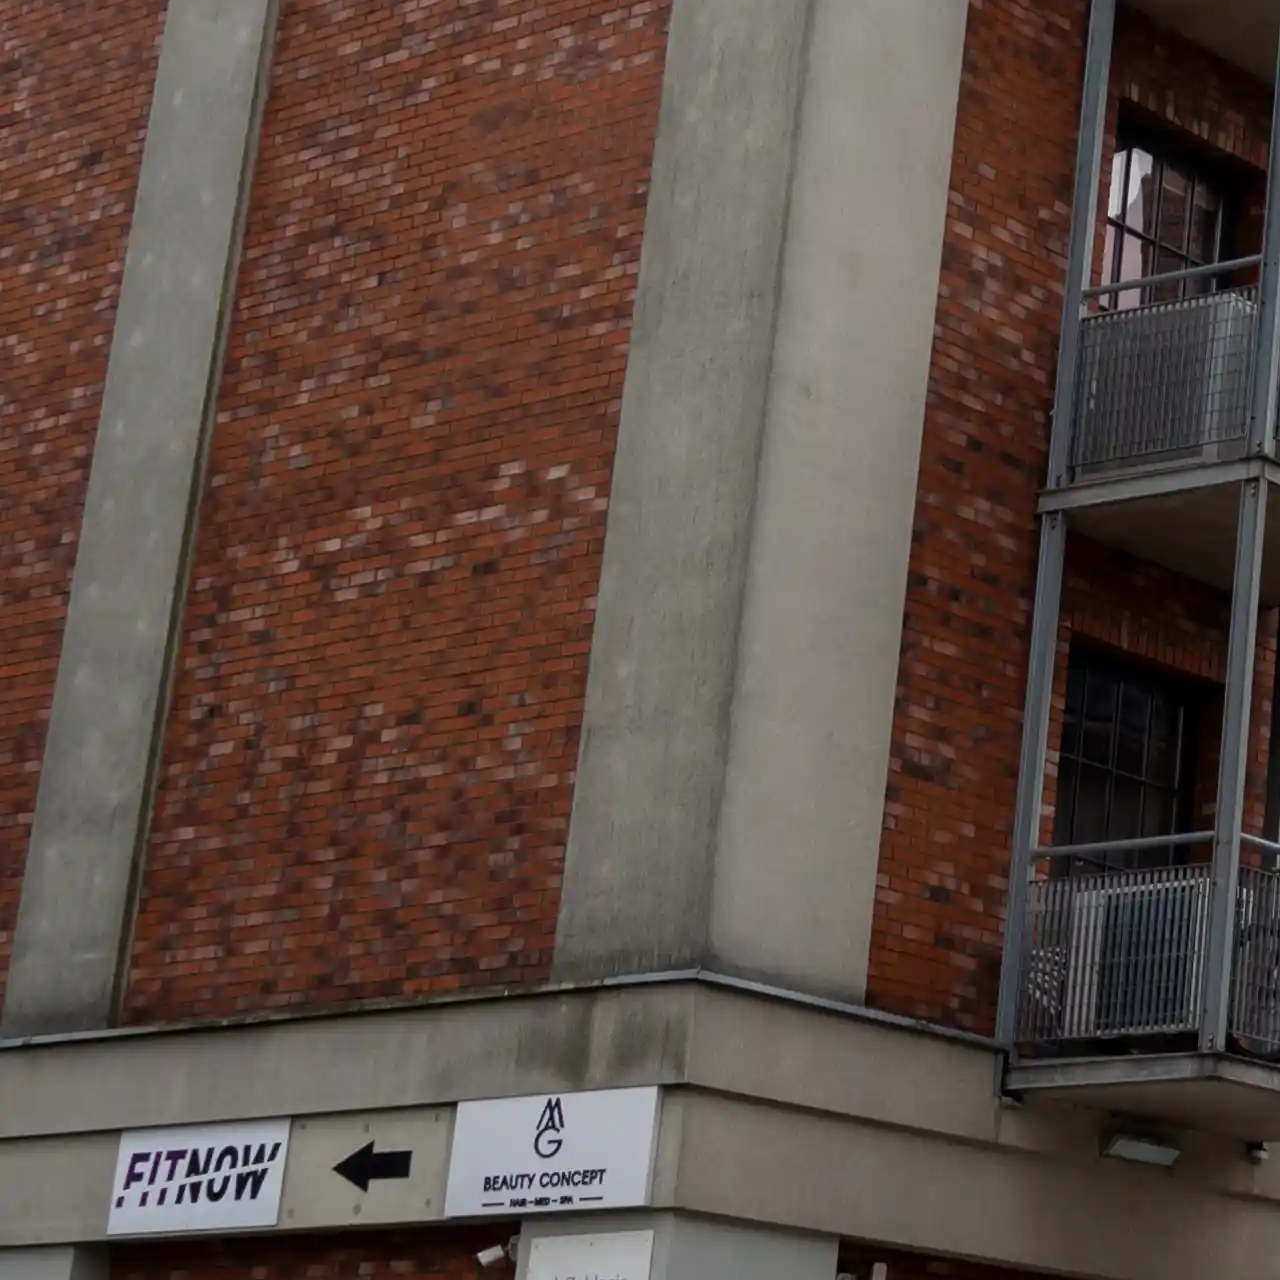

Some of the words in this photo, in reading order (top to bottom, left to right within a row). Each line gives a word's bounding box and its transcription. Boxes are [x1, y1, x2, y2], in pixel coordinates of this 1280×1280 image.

[115, 1142, 282, 1208] FITNOW
[483, 1172, 536, 1192] BEAUTY
[539, 1169, 606, 1188] CONCEPT
